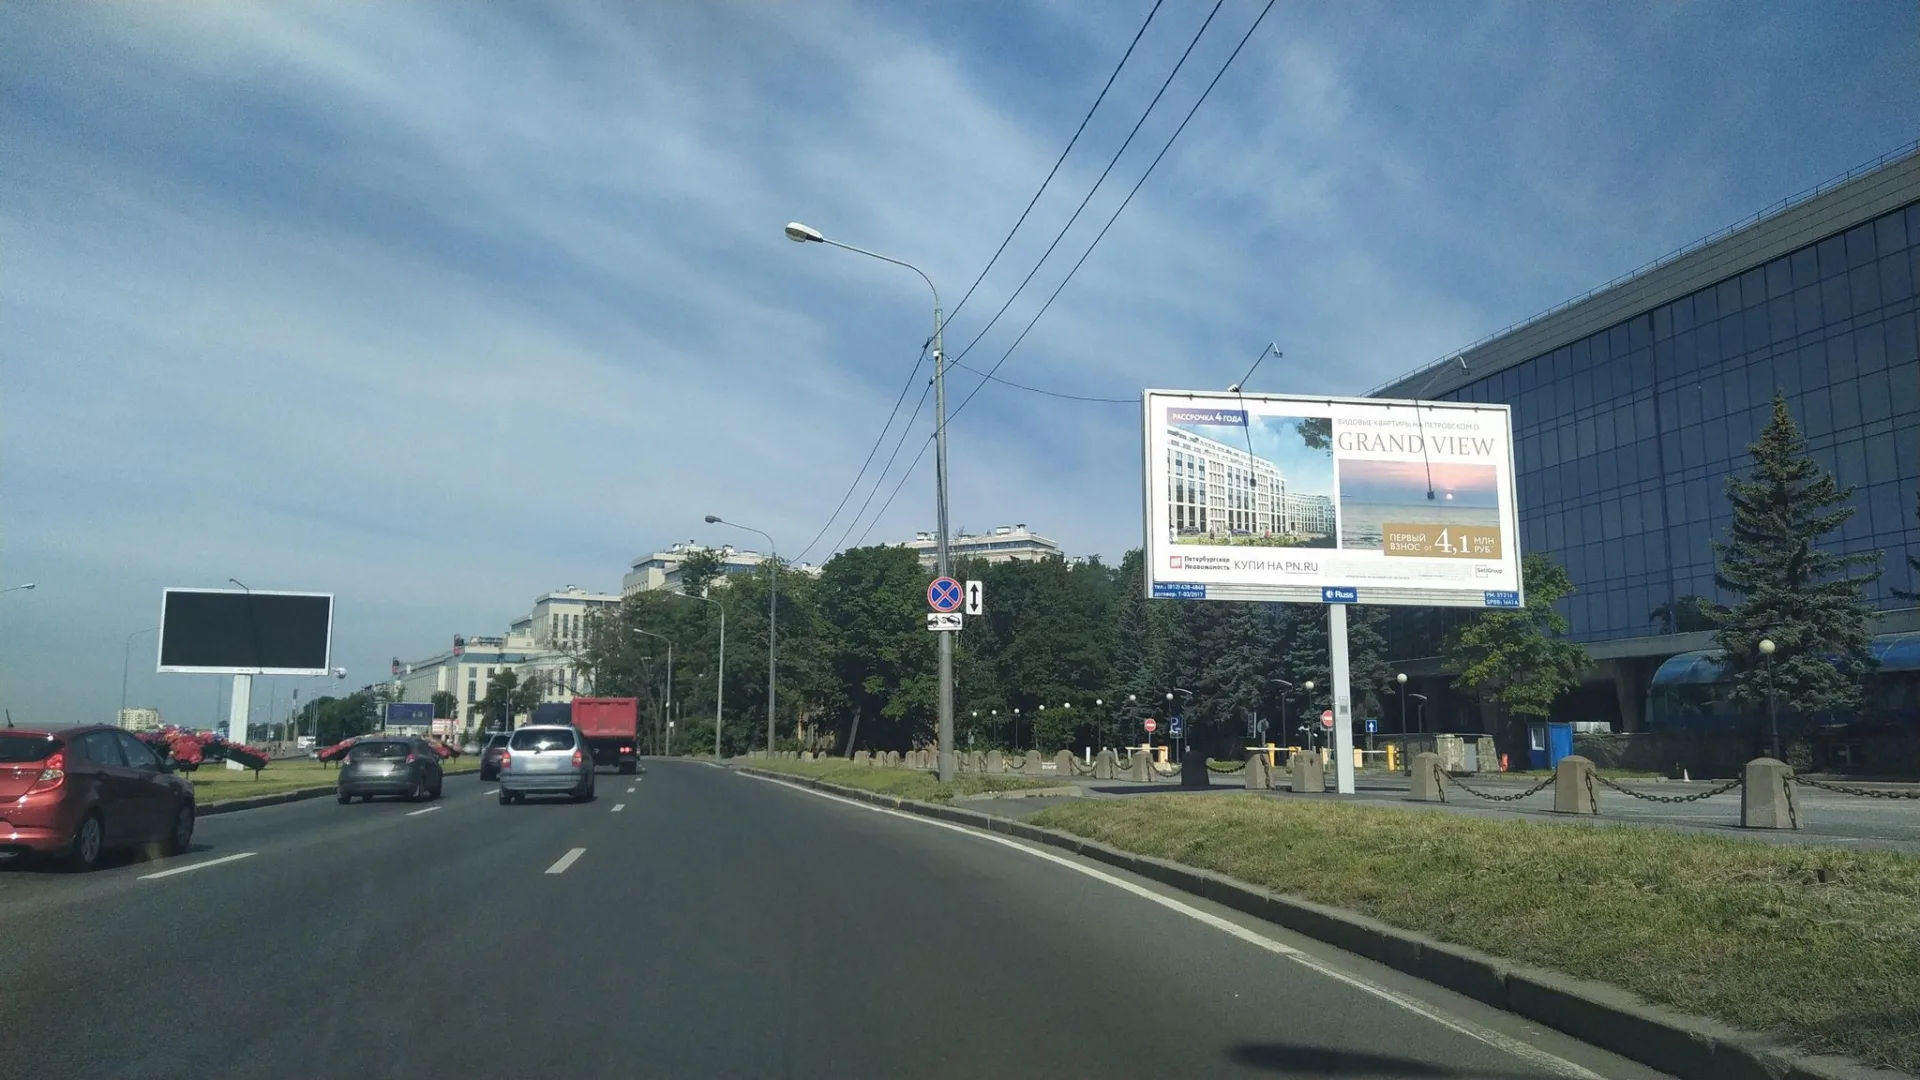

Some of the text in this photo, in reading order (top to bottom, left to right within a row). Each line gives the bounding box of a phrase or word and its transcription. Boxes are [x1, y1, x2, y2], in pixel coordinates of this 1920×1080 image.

[1172, 412, 1243, 423] РАССРОЧКА 4 ГОДА
[1337, 418, 1372, 427] ВИДОВЫЕ
[1373, 420, 1412, 428] КВАРТИРЫ
[1424, 422, 1472, 430] ПЕТРОВСКОМ
[1338, 432, 1494, 456] GRAND VIEW
[1389, 533, 1426, 542] ПЕРВЫЙ
[1434, 528, 1470, 555] 4,1
[1474, 536, 1495, 545] МЛН
[1390, 542, 1420, 551] ВЗНОС
[1234, 560, 1265, 570] КУПИ
[1267, 561, 1284, 571] НА
[1285, 561, 1318, 572] PN.RU
[1335, 590, 1354, 598] Russ
